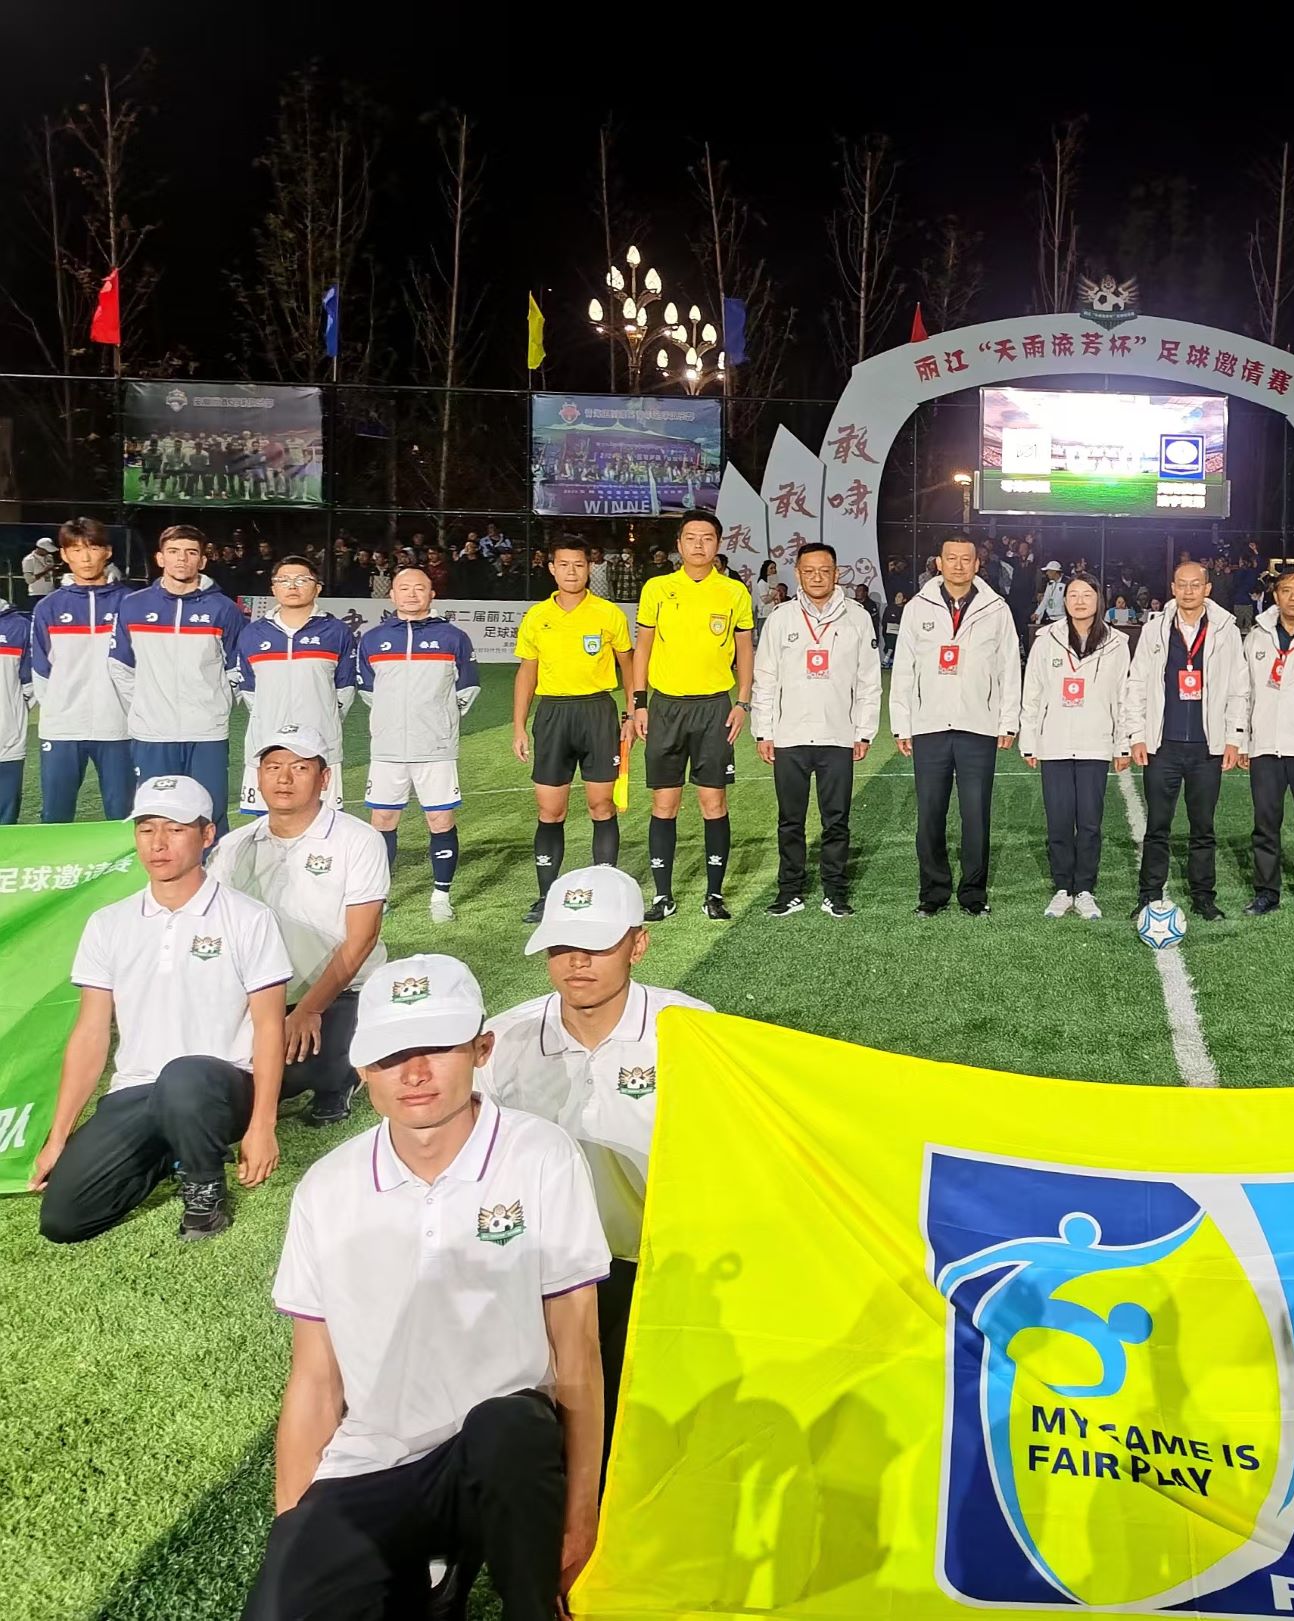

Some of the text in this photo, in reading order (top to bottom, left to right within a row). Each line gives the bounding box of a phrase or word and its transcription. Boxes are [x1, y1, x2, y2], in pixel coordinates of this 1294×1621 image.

[584, 500, 652, 514] WINNE
[1031, 1404, 1089, 1439] MY
[1222, 1444, 1261, 1472] IS
[1028, 1444, 1212, 1498] FAIR PLAY
